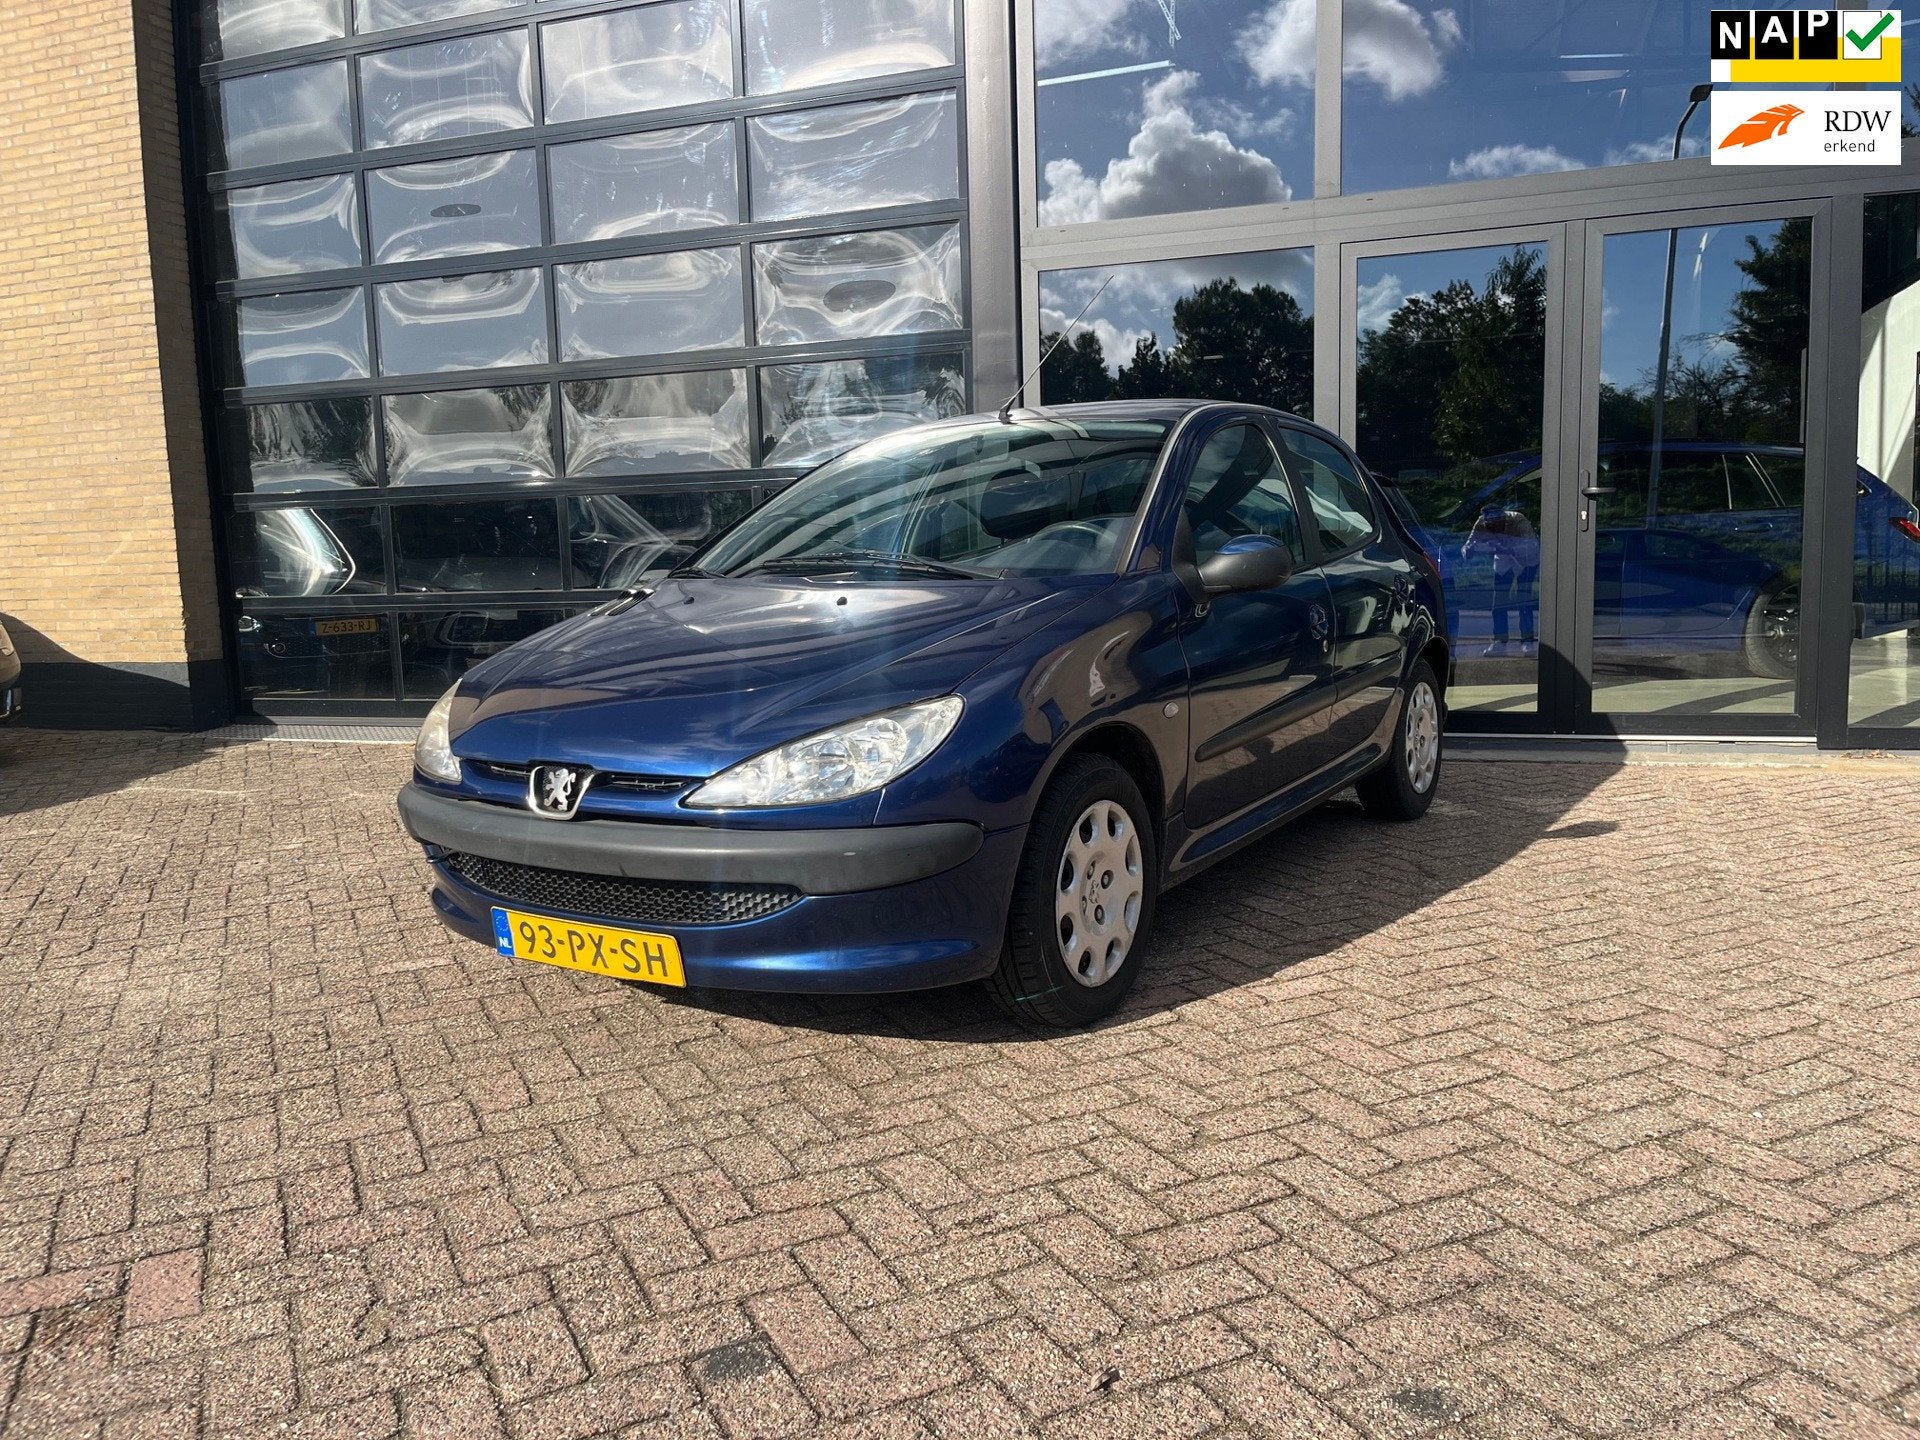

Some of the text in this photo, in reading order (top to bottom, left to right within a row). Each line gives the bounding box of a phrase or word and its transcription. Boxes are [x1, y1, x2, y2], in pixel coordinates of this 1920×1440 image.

[321, 619, 371, 634] Z-633-RJ
[499, 937, 512, 949] NL
[519, 921, 669, 977] 93-PX-SH
